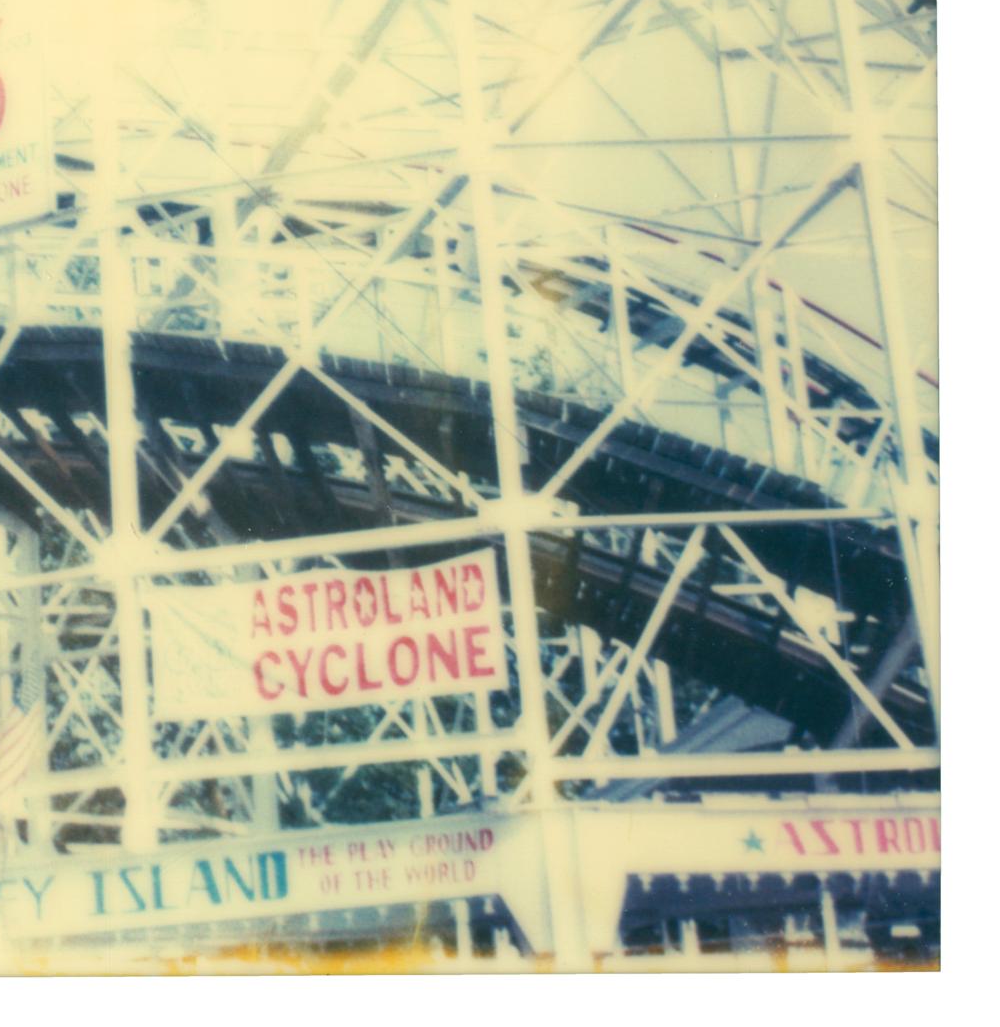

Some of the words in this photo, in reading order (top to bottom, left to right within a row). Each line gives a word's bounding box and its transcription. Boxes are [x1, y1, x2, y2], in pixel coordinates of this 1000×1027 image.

[250, 561, 486, 639] ASTROLAND
[252, 625, 496, 701] CYCLONE
[88, 850, 289, 916] ISLAND
[297, 843, 335, 869] THE
[318, 871, 342, 895] OF
[352, 867, 393, 893] THE
[404, 858, 478, 885] WORLD
